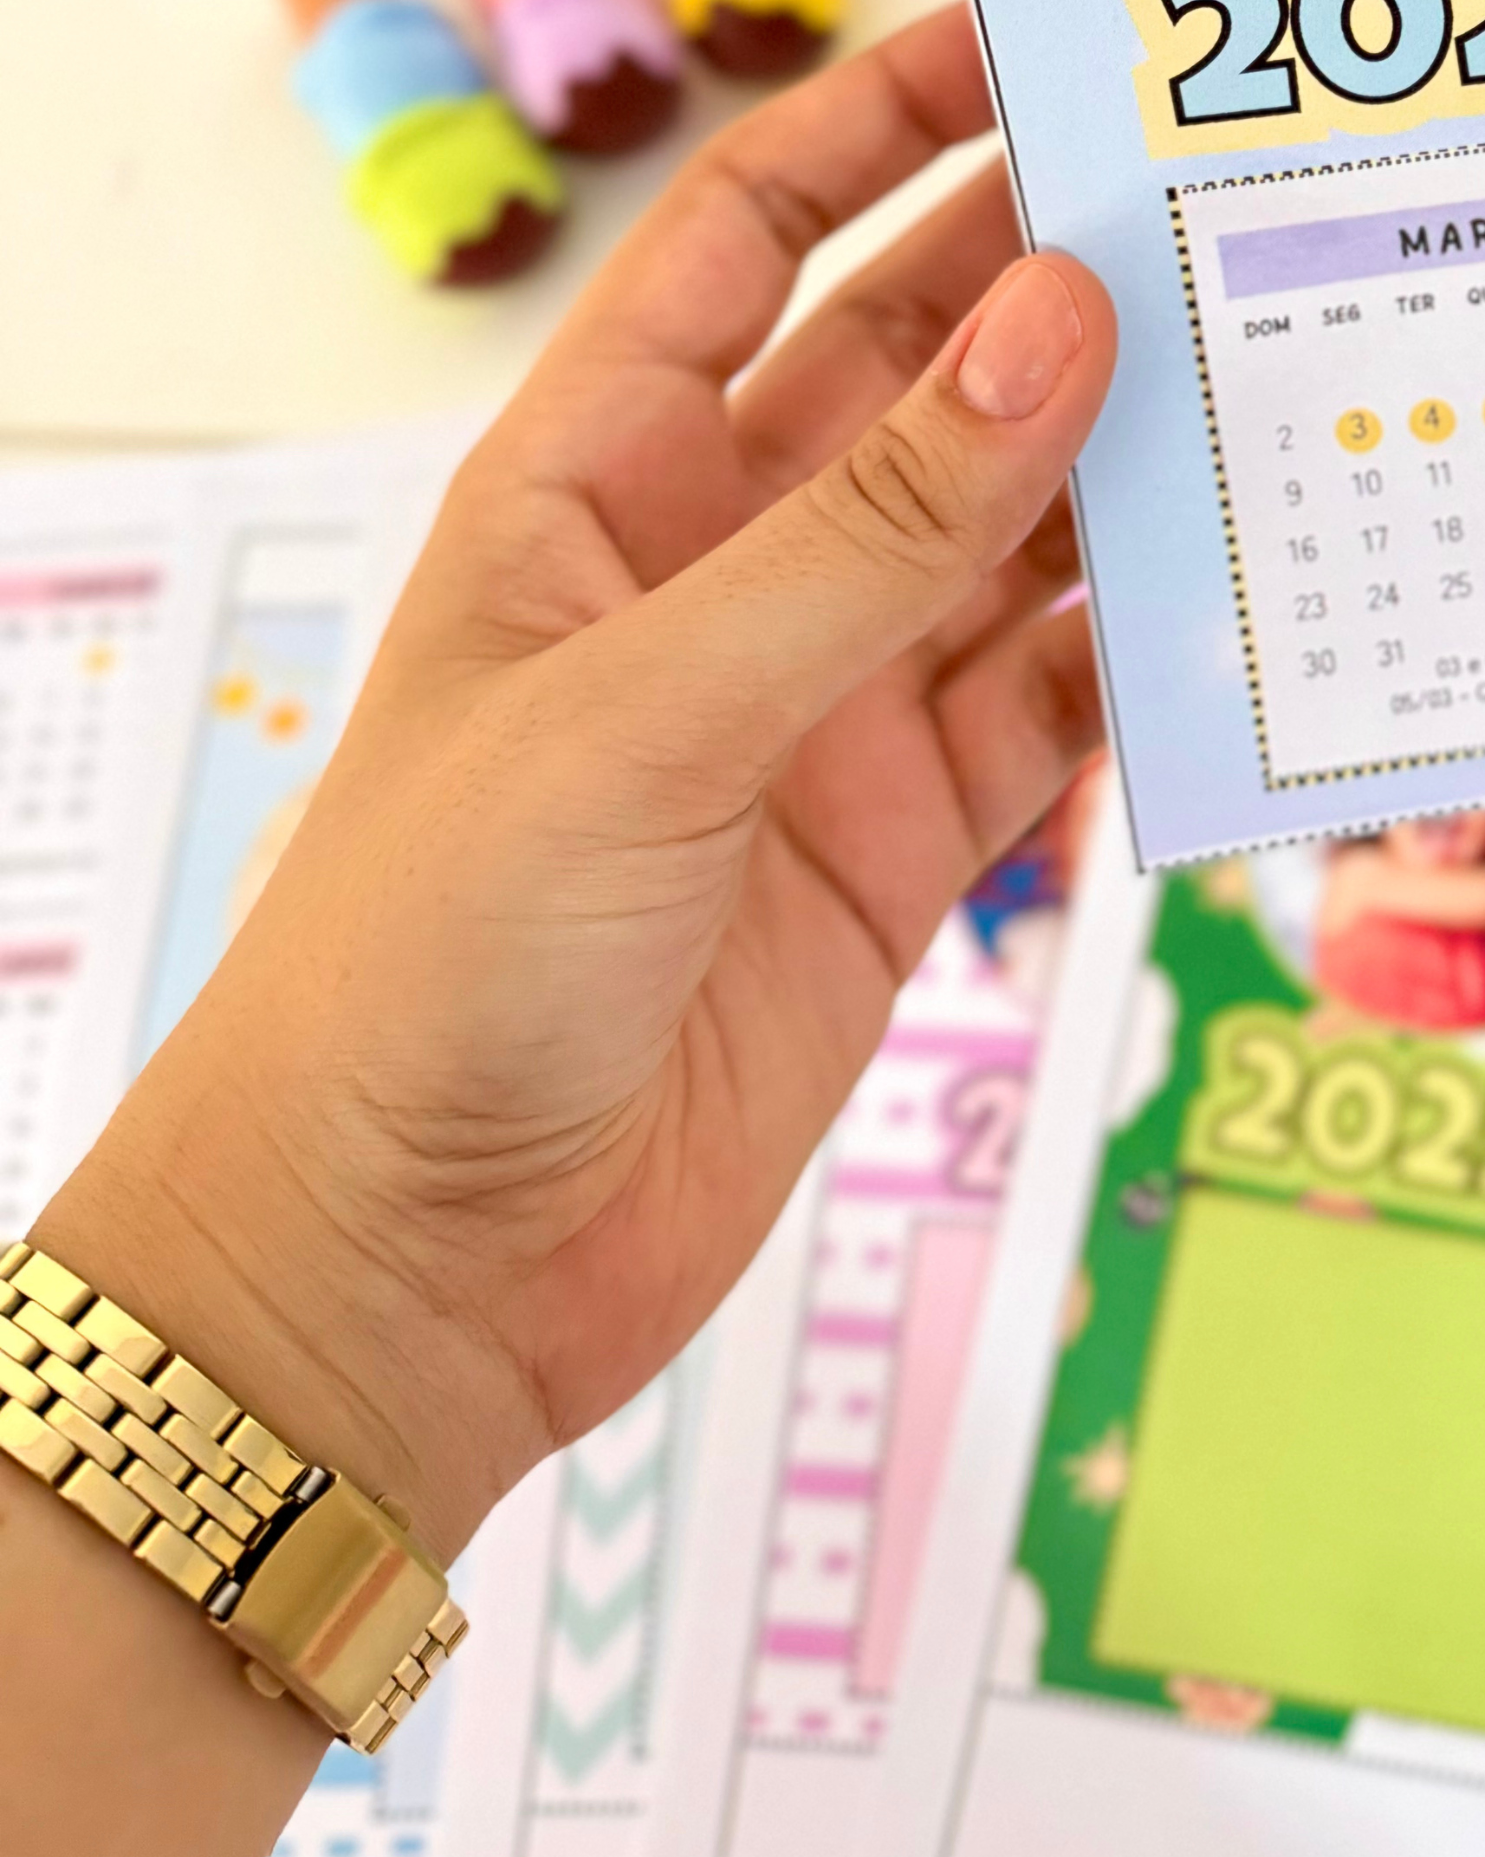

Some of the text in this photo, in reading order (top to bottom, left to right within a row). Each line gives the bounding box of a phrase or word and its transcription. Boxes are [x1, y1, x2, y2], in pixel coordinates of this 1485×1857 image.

[1244, 317, 1291, 339] DOM
[1322, 305, 1361, 325] SEG
[1396, 294, 1435, 315] TER
[1278, 426, 1293, 451] 2
[1352, 414, 1368, 440] 3
[1423, 405, 1441, 429] 4
[1286, 480, 1302, 505] 9
[1352, 469, 1383, 496] 10
[1426, 461, 1452, 486] 11
[1288, 536, 1318, 563] 16
[1361, 526, 1388, 553] 17
[1433, 516, 1463, 543] 18
[1295, 593, 1327, 621] 23
[1368, 583, 1399, 611] 24
[1440, 572, 1472, 600] 25
[1303, 640, 1406, 678] 30 31
[1436, 656, 1461, 678] 03
[1468, 658, 1480, 673] e
[1390, 688, 1453, 714] 05/03
